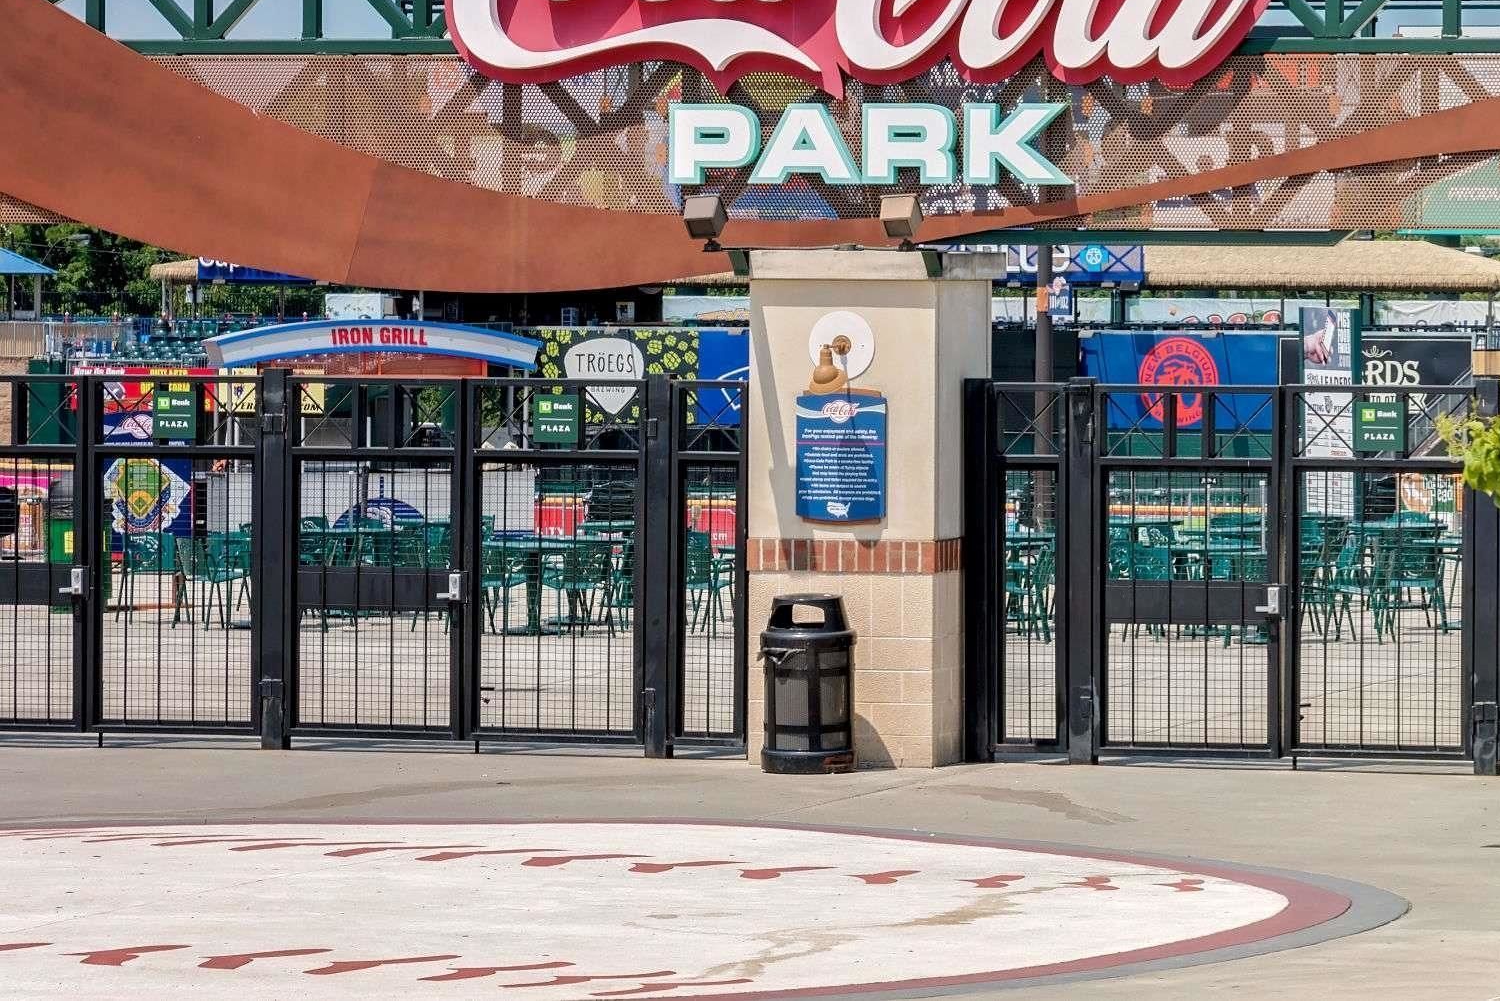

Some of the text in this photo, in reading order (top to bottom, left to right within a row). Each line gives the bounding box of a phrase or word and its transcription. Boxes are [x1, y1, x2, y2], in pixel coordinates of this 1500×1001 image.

[668, 101, 1074, 186] PARK
[331, 327, 429, 347] IRON GRILL
[575, 352, 634, 373] TRÖEGS
[1166, 344, 1213, 384] BELGIUM
[159, 419, 189, 428] PLAZA
[541, 424, 571, 432] PLAZA
[1364, 432, 1395, 440] PLAZA
